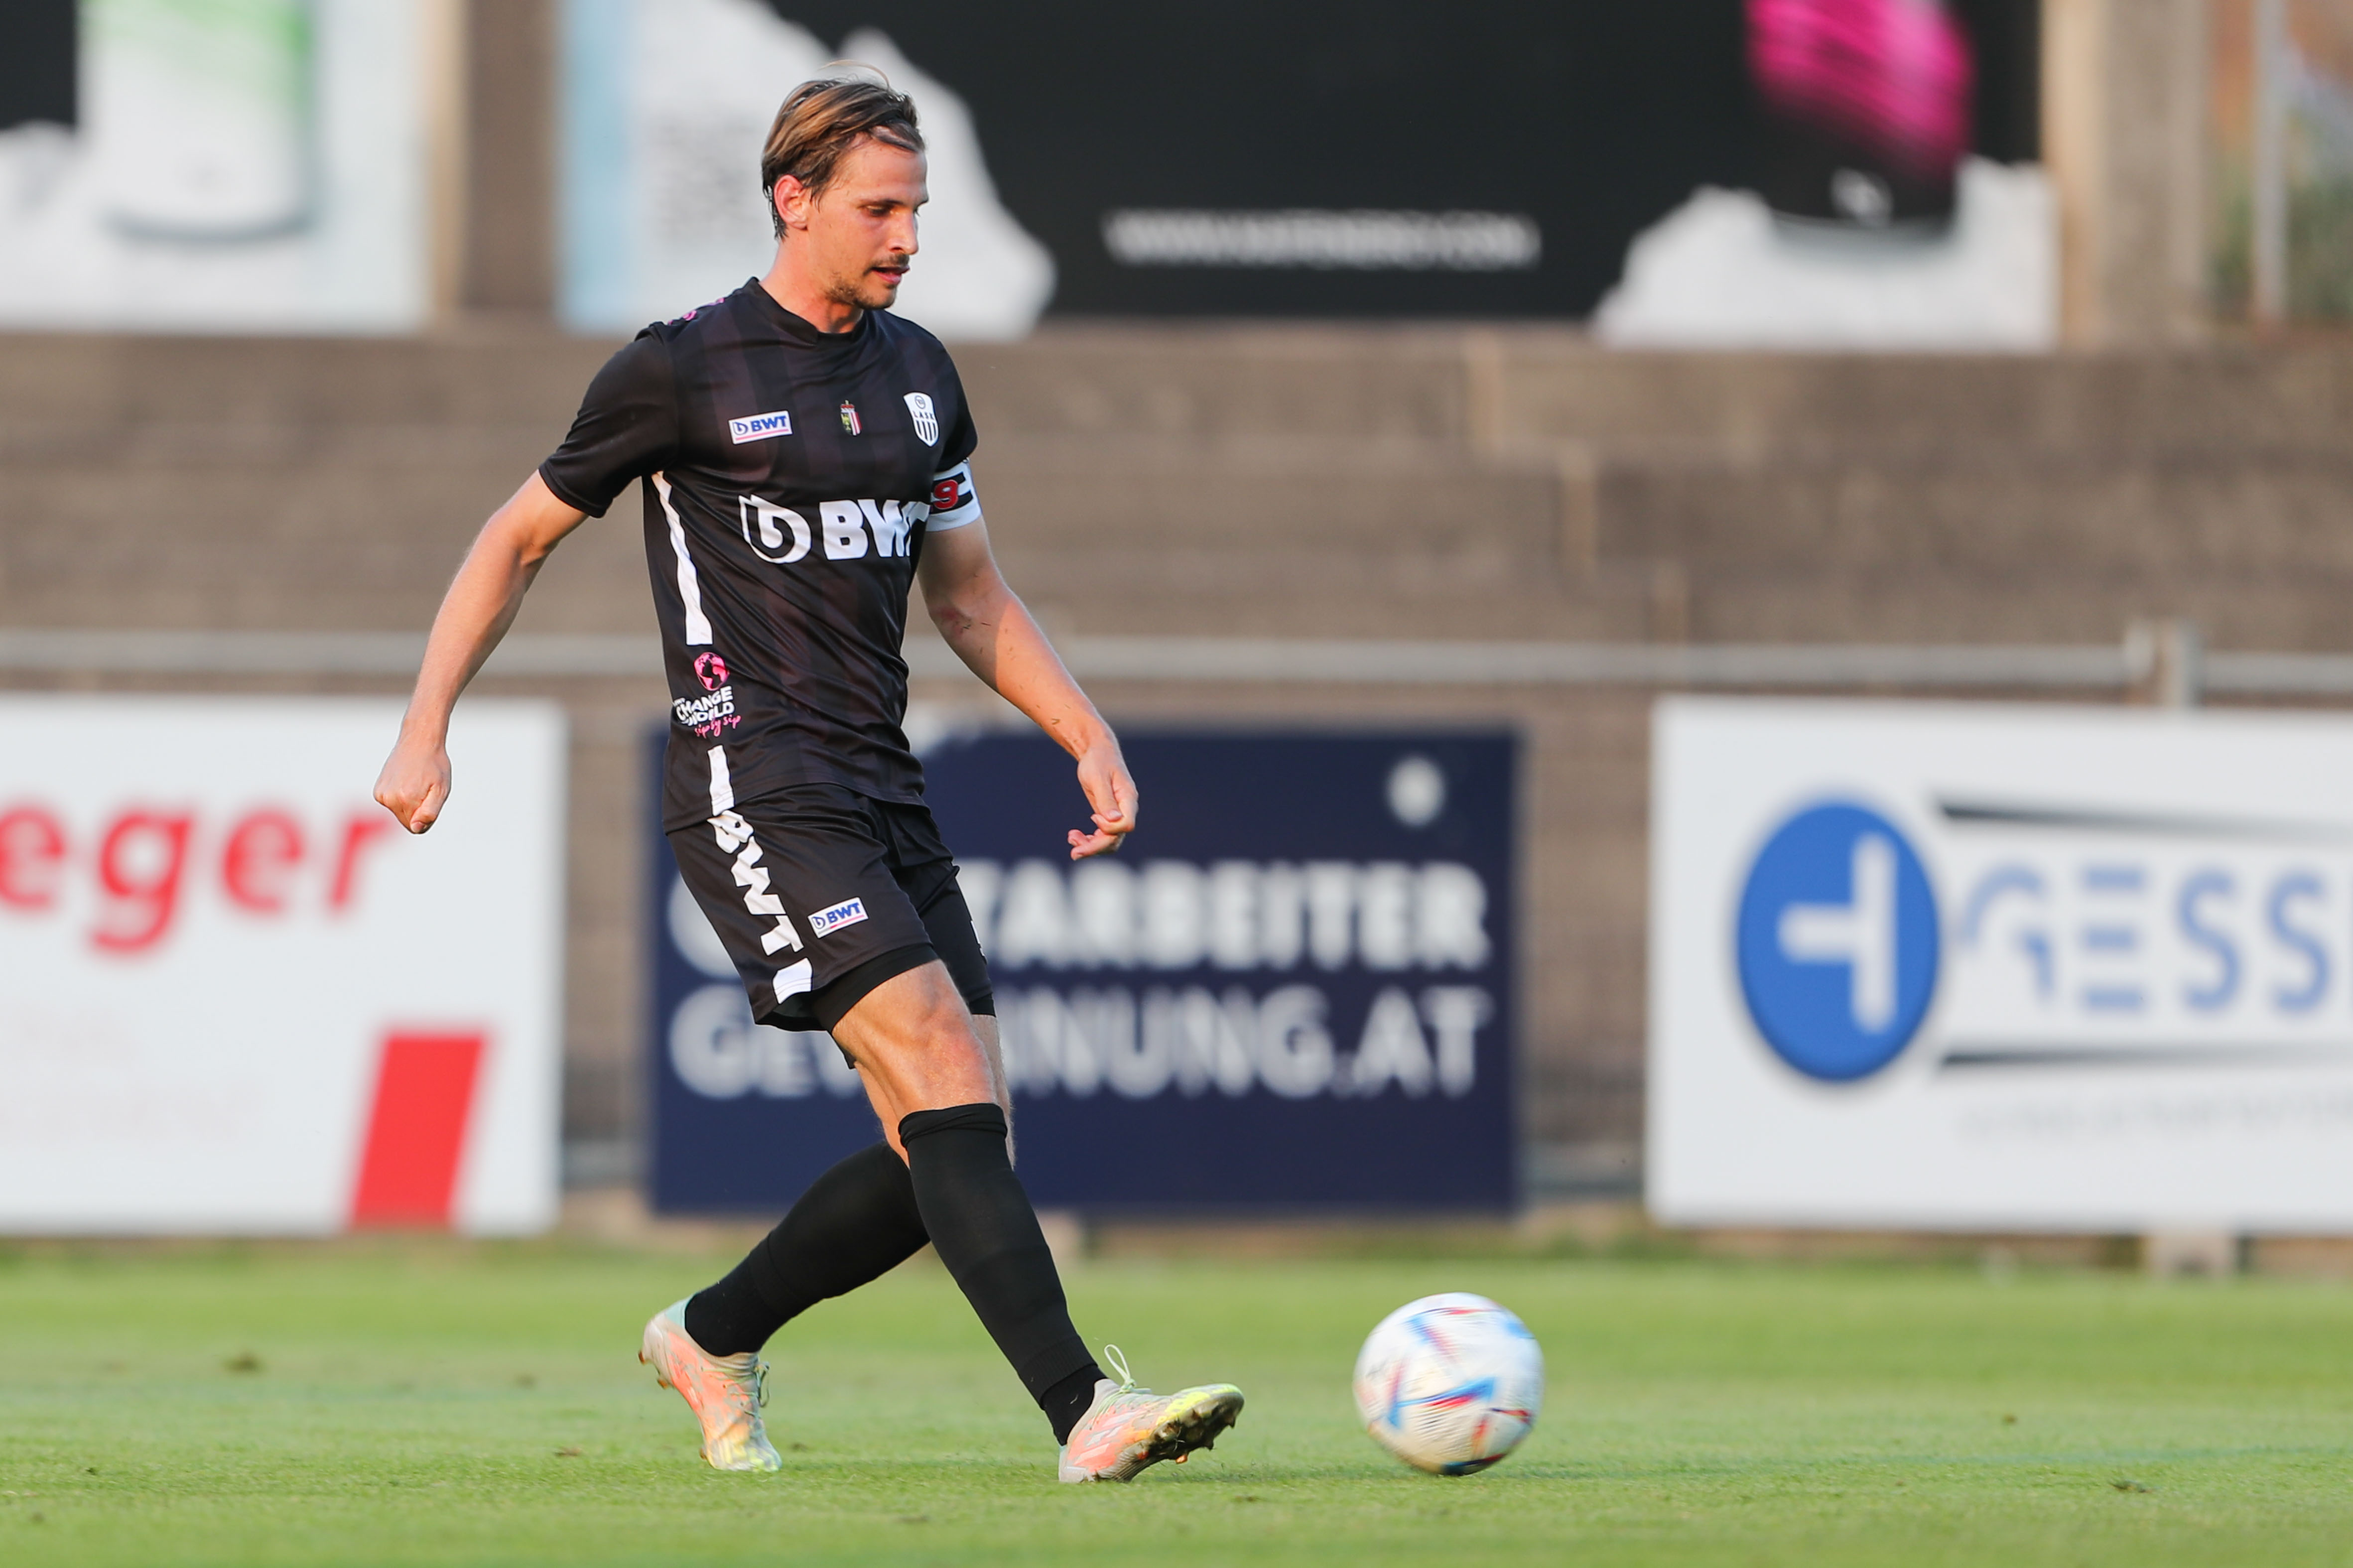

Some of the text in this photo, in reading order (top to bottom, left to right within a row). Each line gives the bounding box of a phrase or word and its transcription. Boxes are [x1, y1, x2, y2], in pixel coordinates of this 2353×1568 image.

[751, 415, 787, 432] BWT
[913, 411, 934, 420] LASK
[676, 685, 733, 721] CHANGE
[723, 714, 741, 729] sip
[826, 902, 861, 924] BWT
